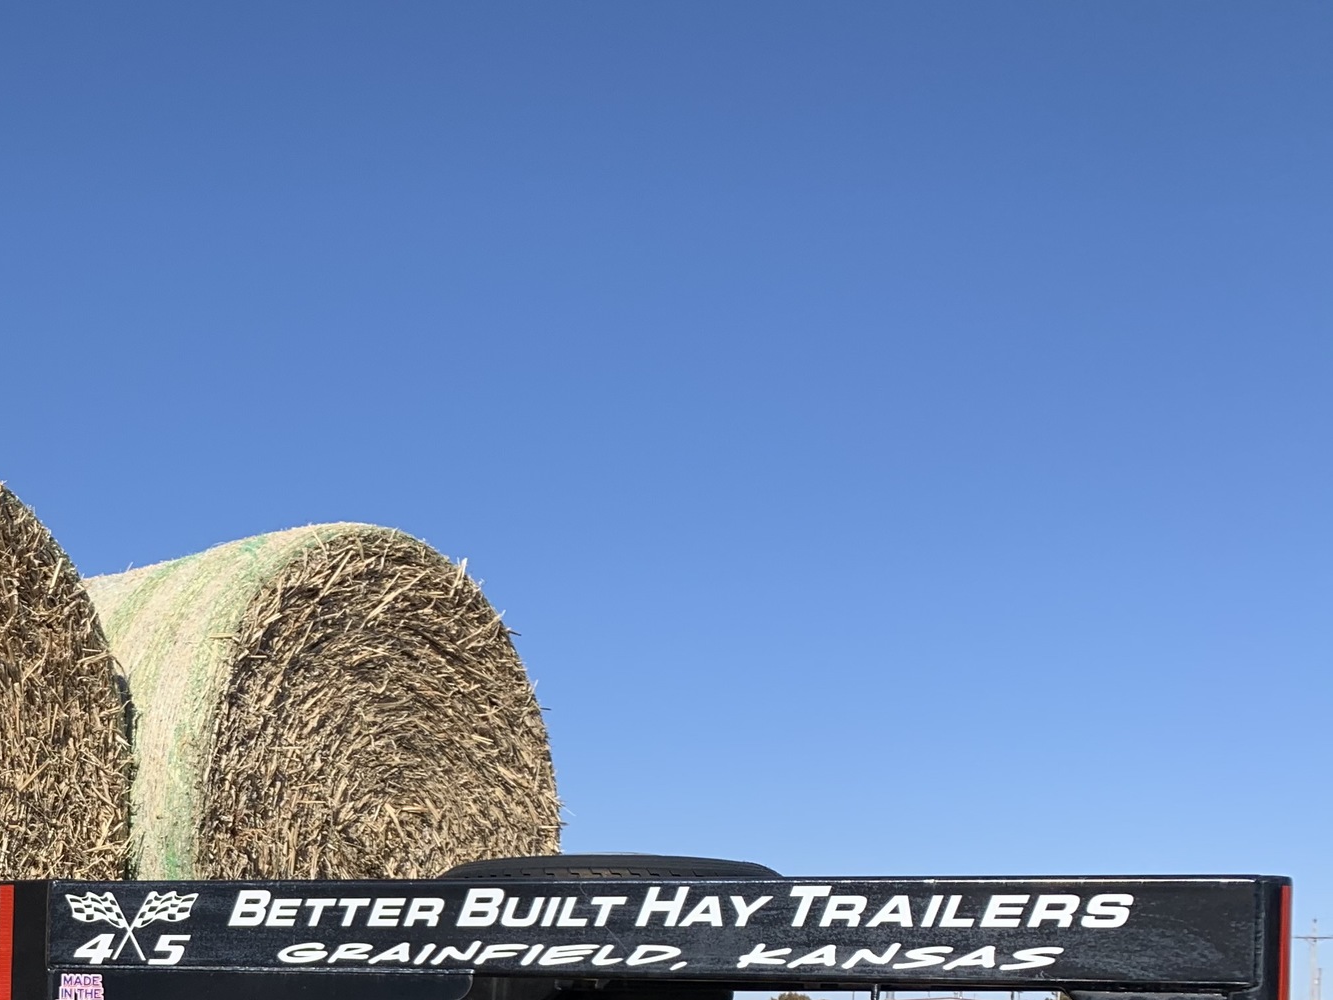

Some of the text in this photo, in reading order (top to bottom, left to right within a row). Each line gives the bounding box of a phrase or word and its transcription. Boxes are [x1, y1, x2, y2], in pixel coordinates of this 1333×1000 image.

[227, 885, 1134, 928] BETTER BUILT HAY TRAILERS
[276, 940, 1065, 971] GRAINFIELD, KANSAS
[62, 974, 102, 987] MADE
[60, 987, 104, 1000] IN THE
